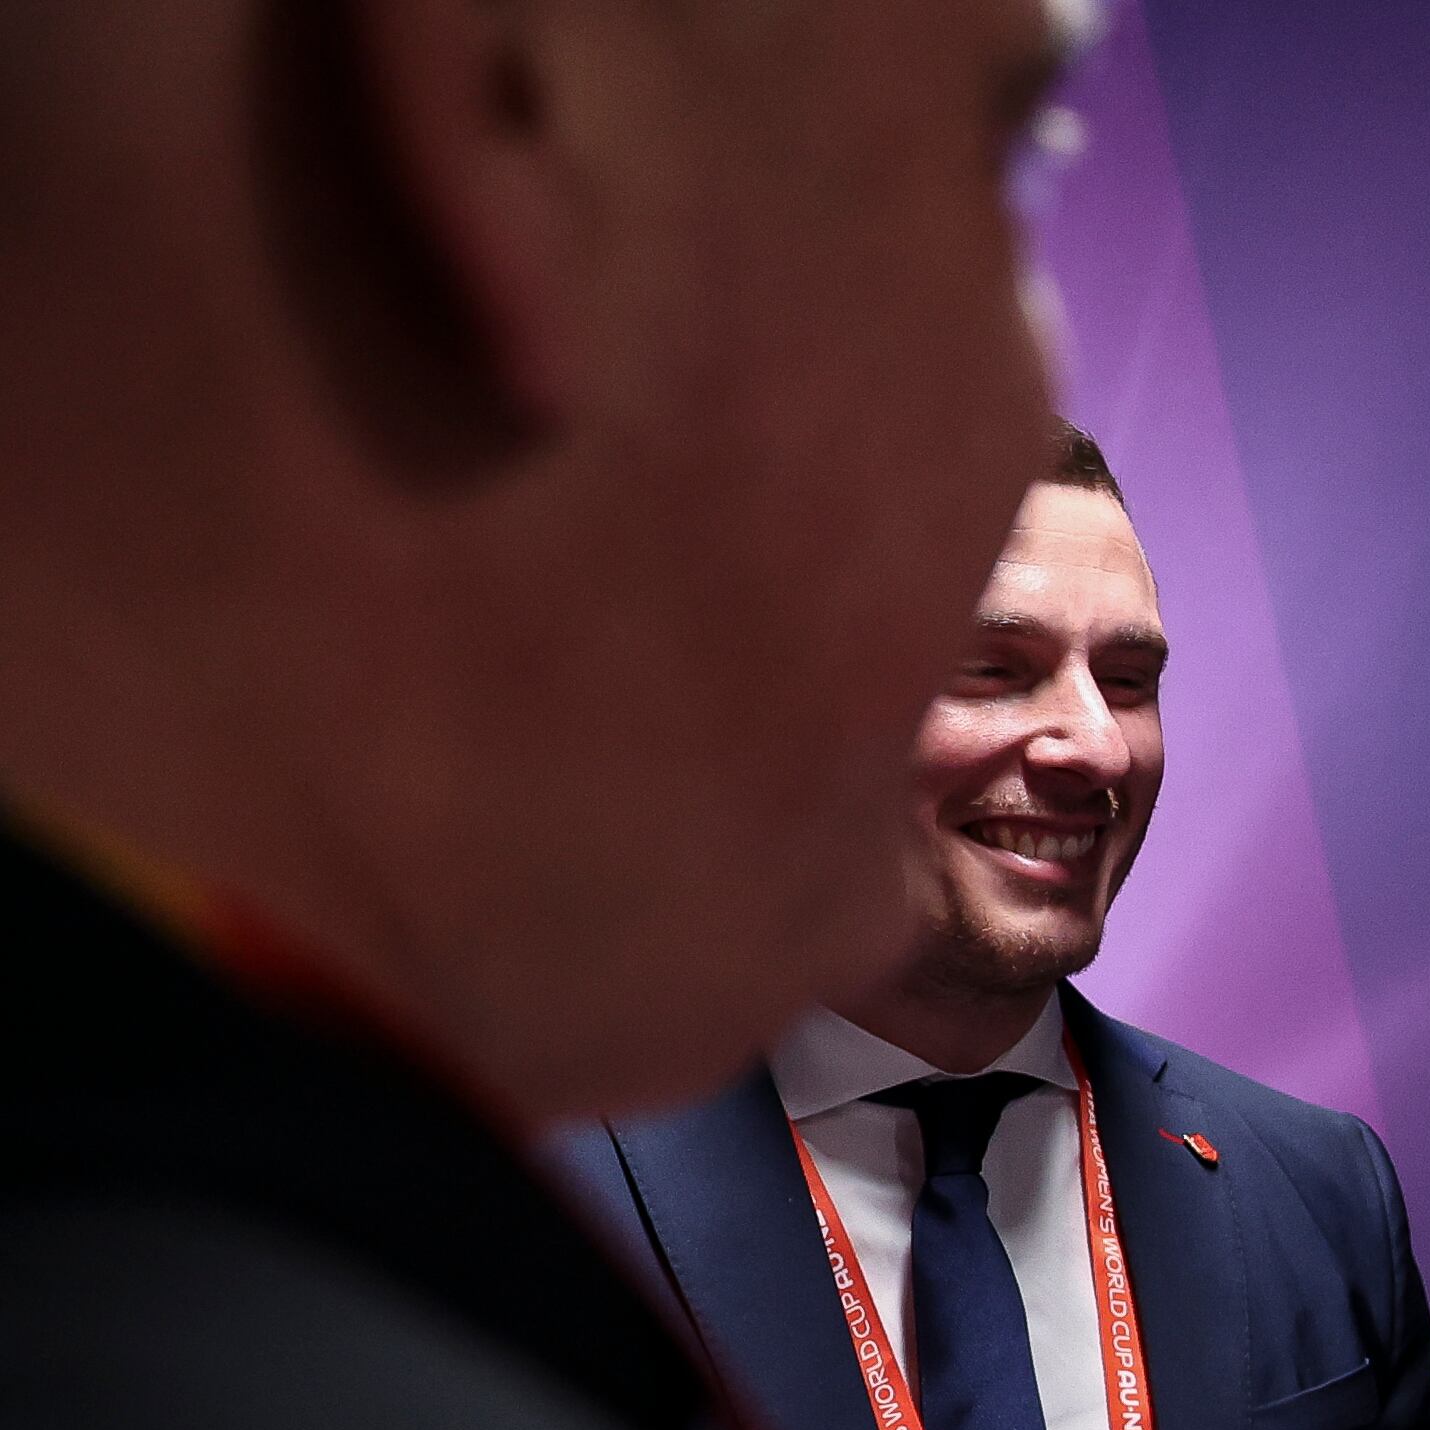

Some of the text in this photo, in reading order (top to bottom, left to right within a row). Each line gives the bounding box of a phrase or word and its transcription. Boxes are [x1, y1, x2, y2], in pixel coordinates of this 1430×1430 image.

[1102, 1237, 1127, 1318] WORLD
[840, 1292, 871, 1339] CUP
[1111, 1321, 1134, 1366] CUP
[860, 1339, 902, 1428] WORLD
